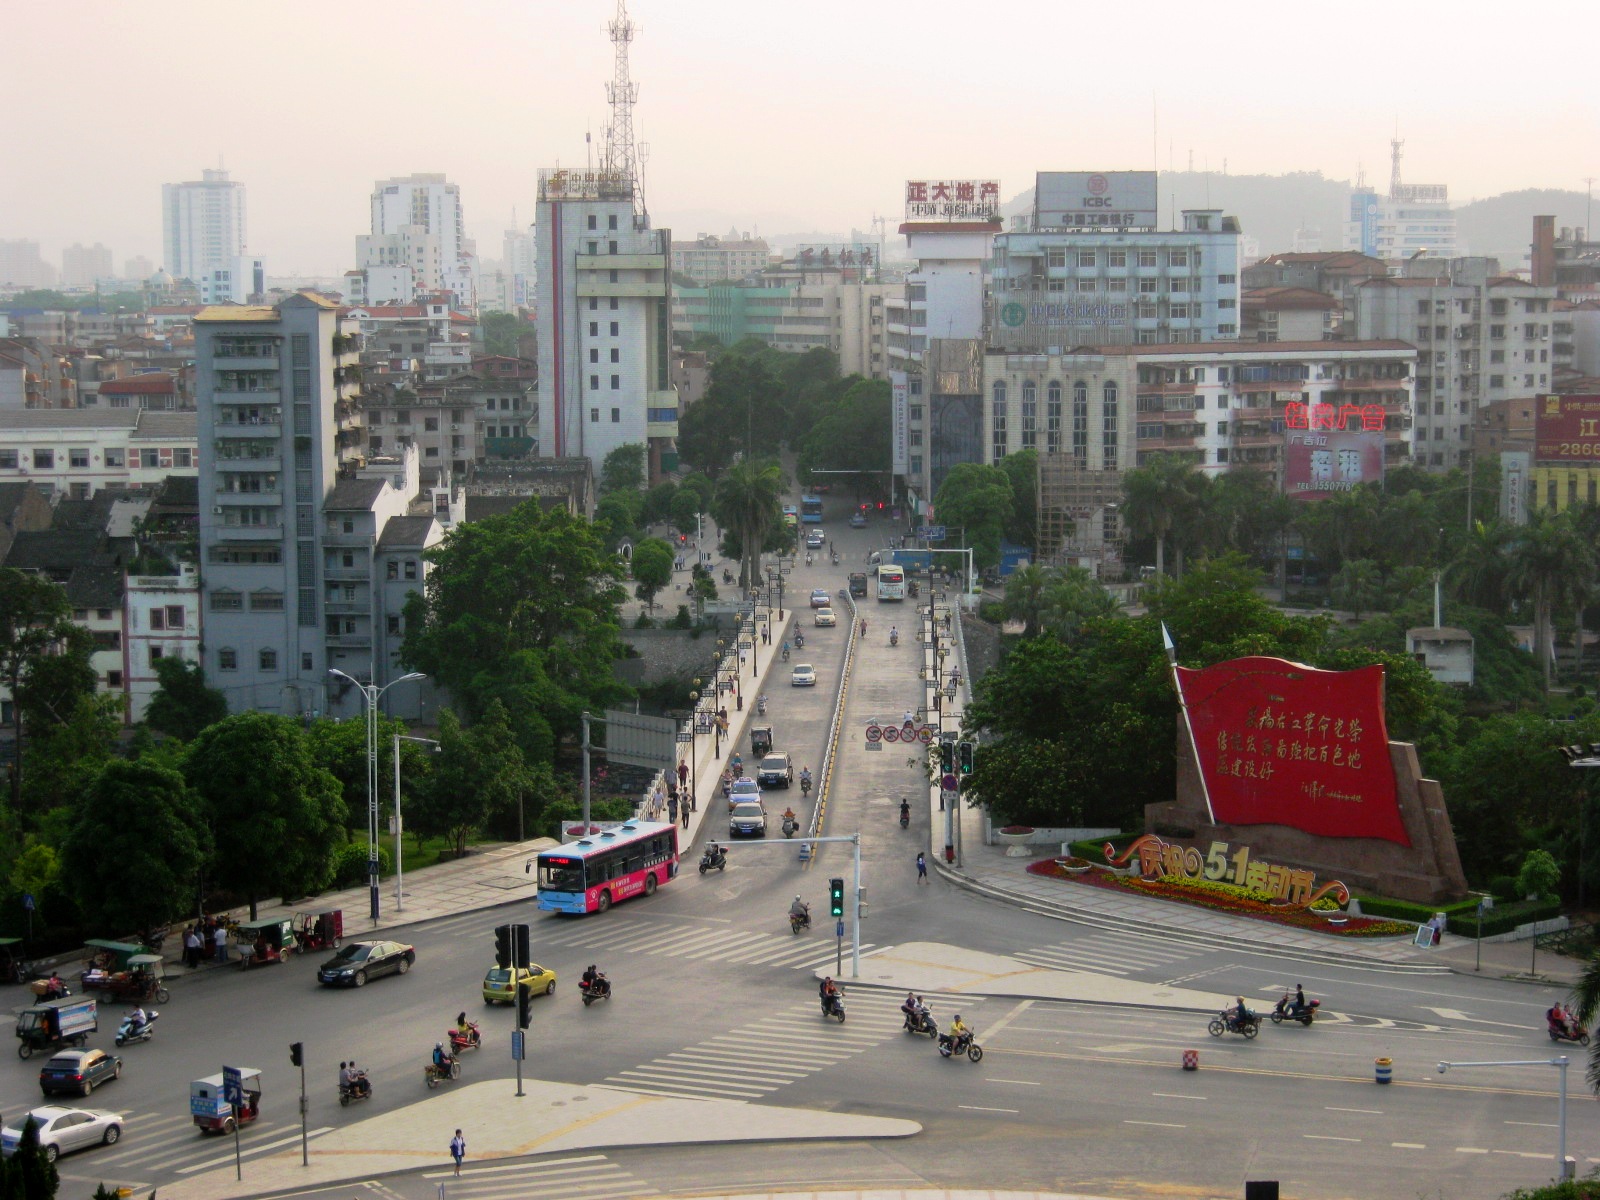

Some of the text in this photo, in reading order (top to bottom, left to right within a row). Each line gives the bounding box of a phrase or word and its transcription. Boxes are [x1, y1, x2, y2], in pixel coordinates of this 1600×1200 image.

[907, 182, 998, 203] 正大地产
[1082, 197, 1112, 207] ICBC
[1062, 213, 1135, 225] 中国工商银行
[1290, 435, 1328, 447] 广告位
